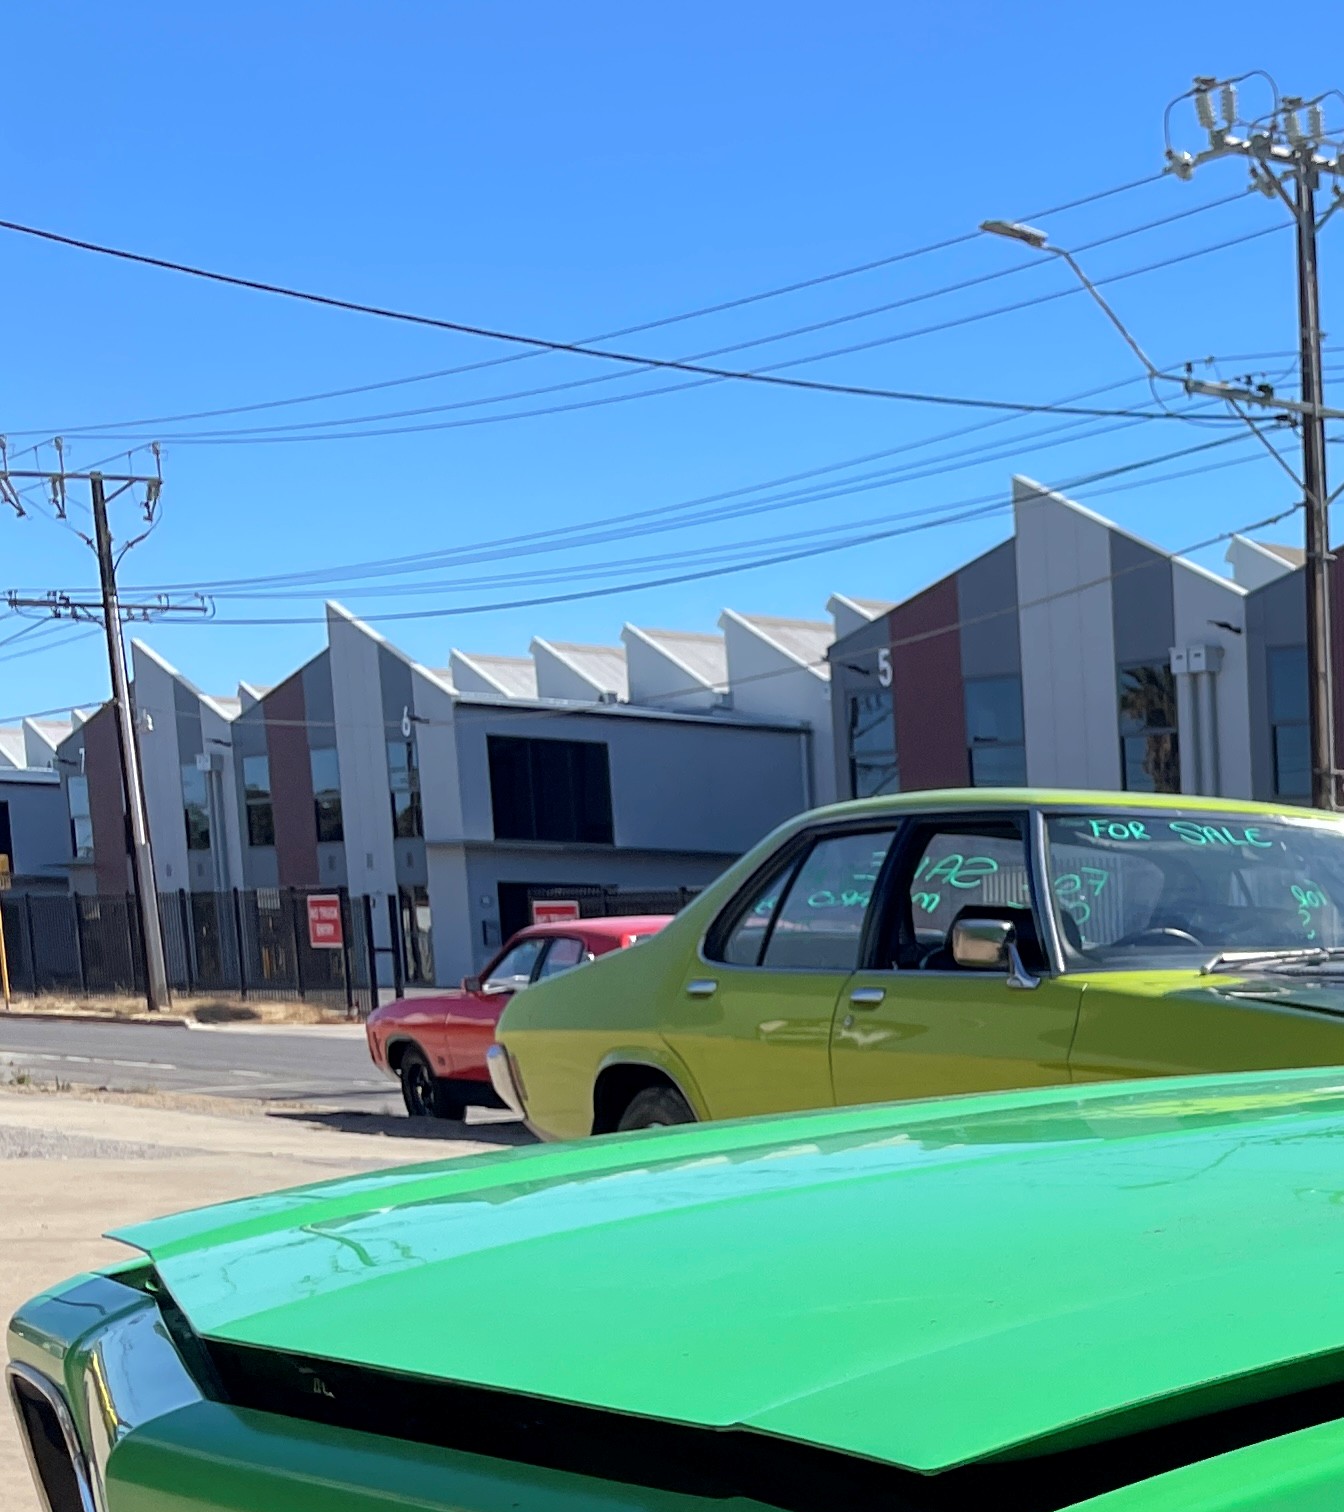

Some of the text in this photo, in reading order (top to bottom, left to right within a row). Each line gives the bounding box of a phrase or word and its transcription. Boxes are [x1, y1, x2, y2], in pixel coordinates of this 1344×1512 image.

[878, 647, 893, 688] 5
[402, 705, 411, 738] 6
[1089, 819, 1273, 848] FOR SALE
